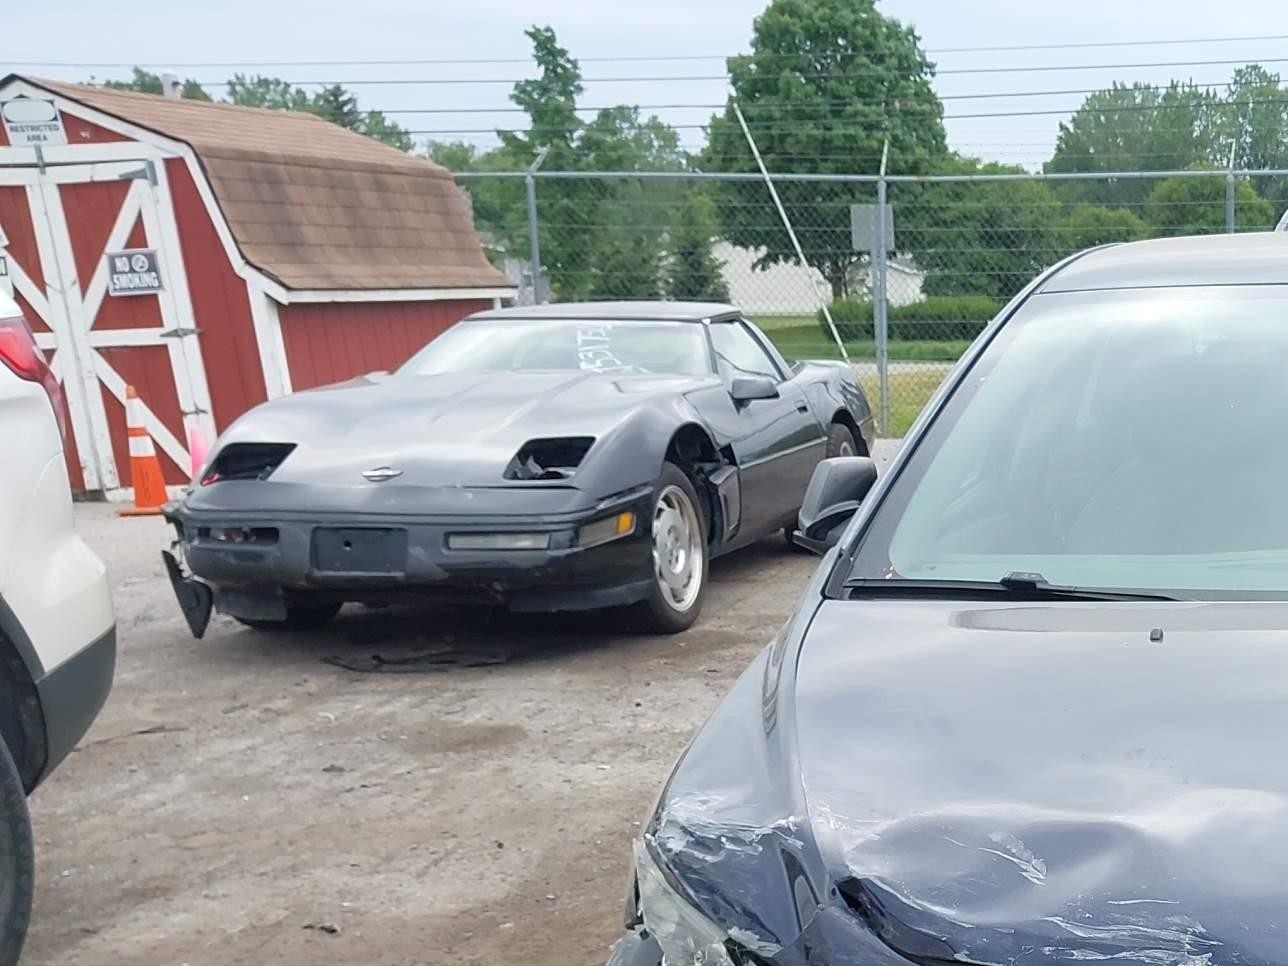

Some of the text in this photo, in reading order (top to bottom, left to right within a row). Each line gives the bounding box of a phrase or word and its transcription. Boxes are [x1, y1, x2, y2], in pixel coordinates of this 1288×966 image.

[9, 123, 60, 133] RESTRICTED
[26, 134, 49, 142] AREA
[114, 256, 130, 272] NO
[112, 271, 160, 289] SMOKING
